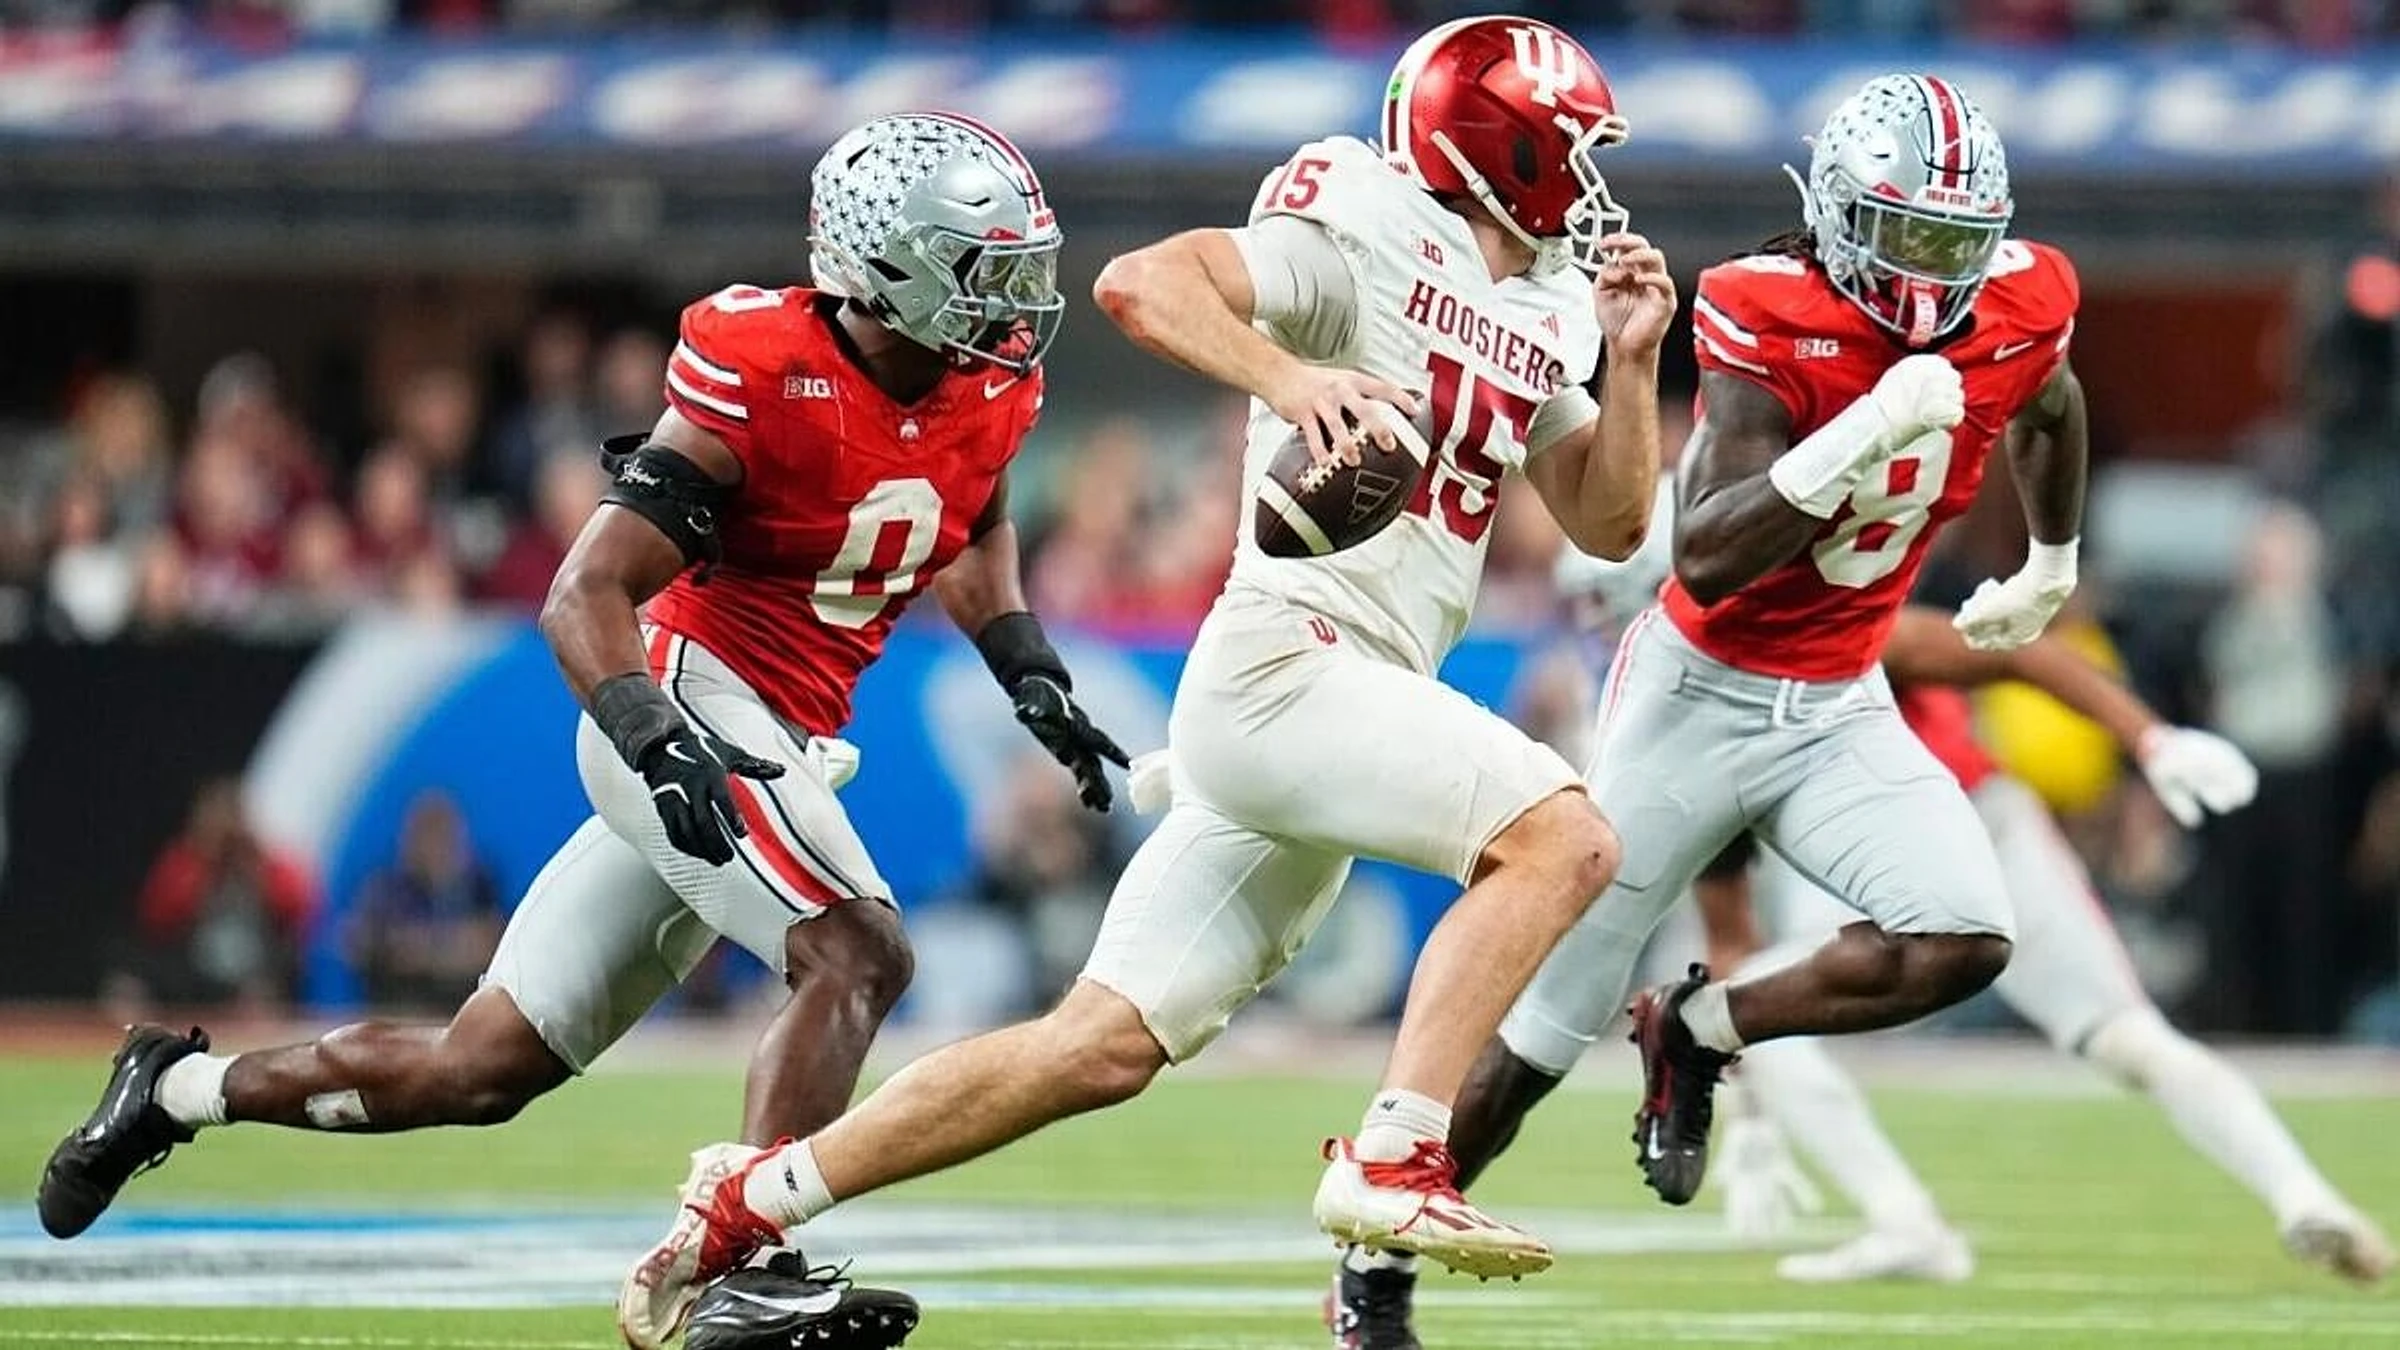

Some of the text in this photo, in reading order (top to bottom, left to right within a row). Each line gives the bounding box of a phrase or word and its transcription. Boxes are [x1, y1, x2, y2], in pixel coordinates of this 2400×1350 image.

[1264, 158, 1332, 209] 15
[1404, 279, 1565, 395] HOOSIERS
[1401, 351, 1538, 545] 15
[1811, 428, 1953, 589] 8
[806, 477, 944, 630] 0
